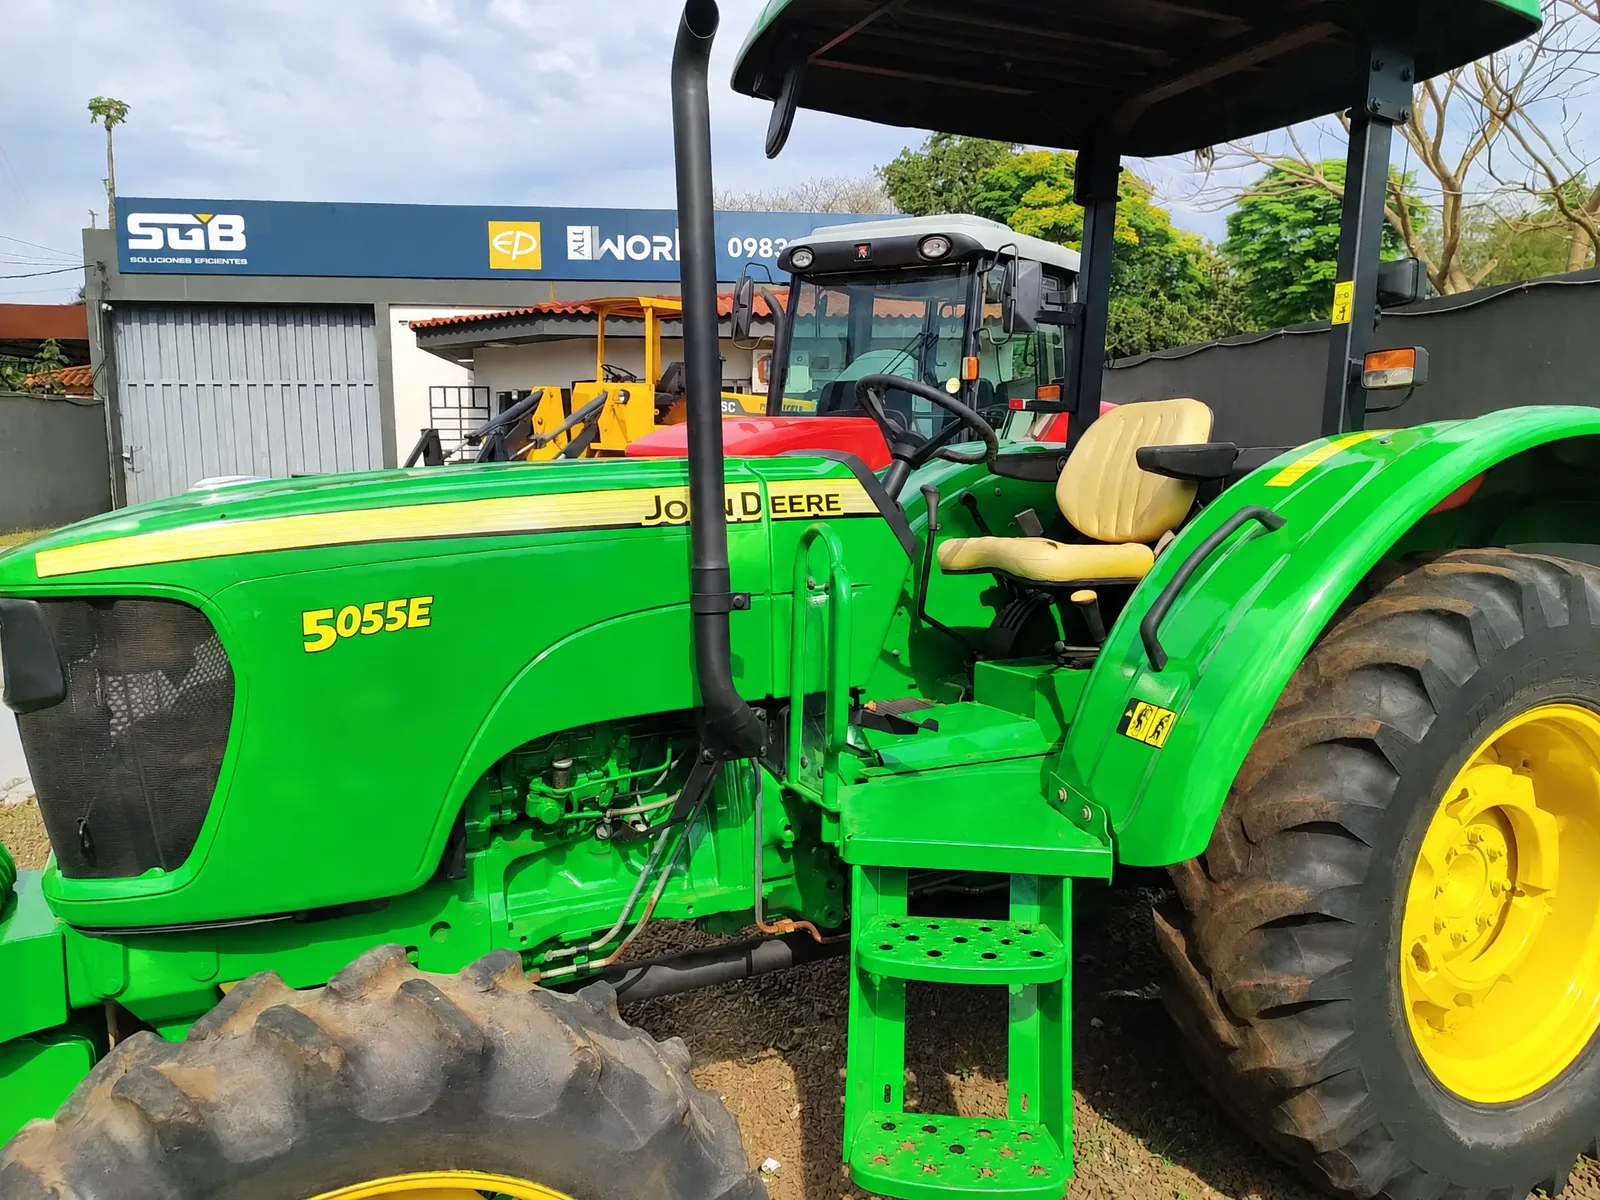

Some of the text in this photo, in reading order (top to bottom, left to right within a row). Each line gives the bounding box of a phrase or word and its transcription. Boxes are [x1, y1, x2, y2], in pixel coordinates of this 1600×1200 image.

[127, 212, 247, 251] SGB
[129, 256, 248, 265] SOLUCIONES EFICIENTES
[645, 491, 842, 520] JO DEERE
[302, 595, 435, 653] 5055E
